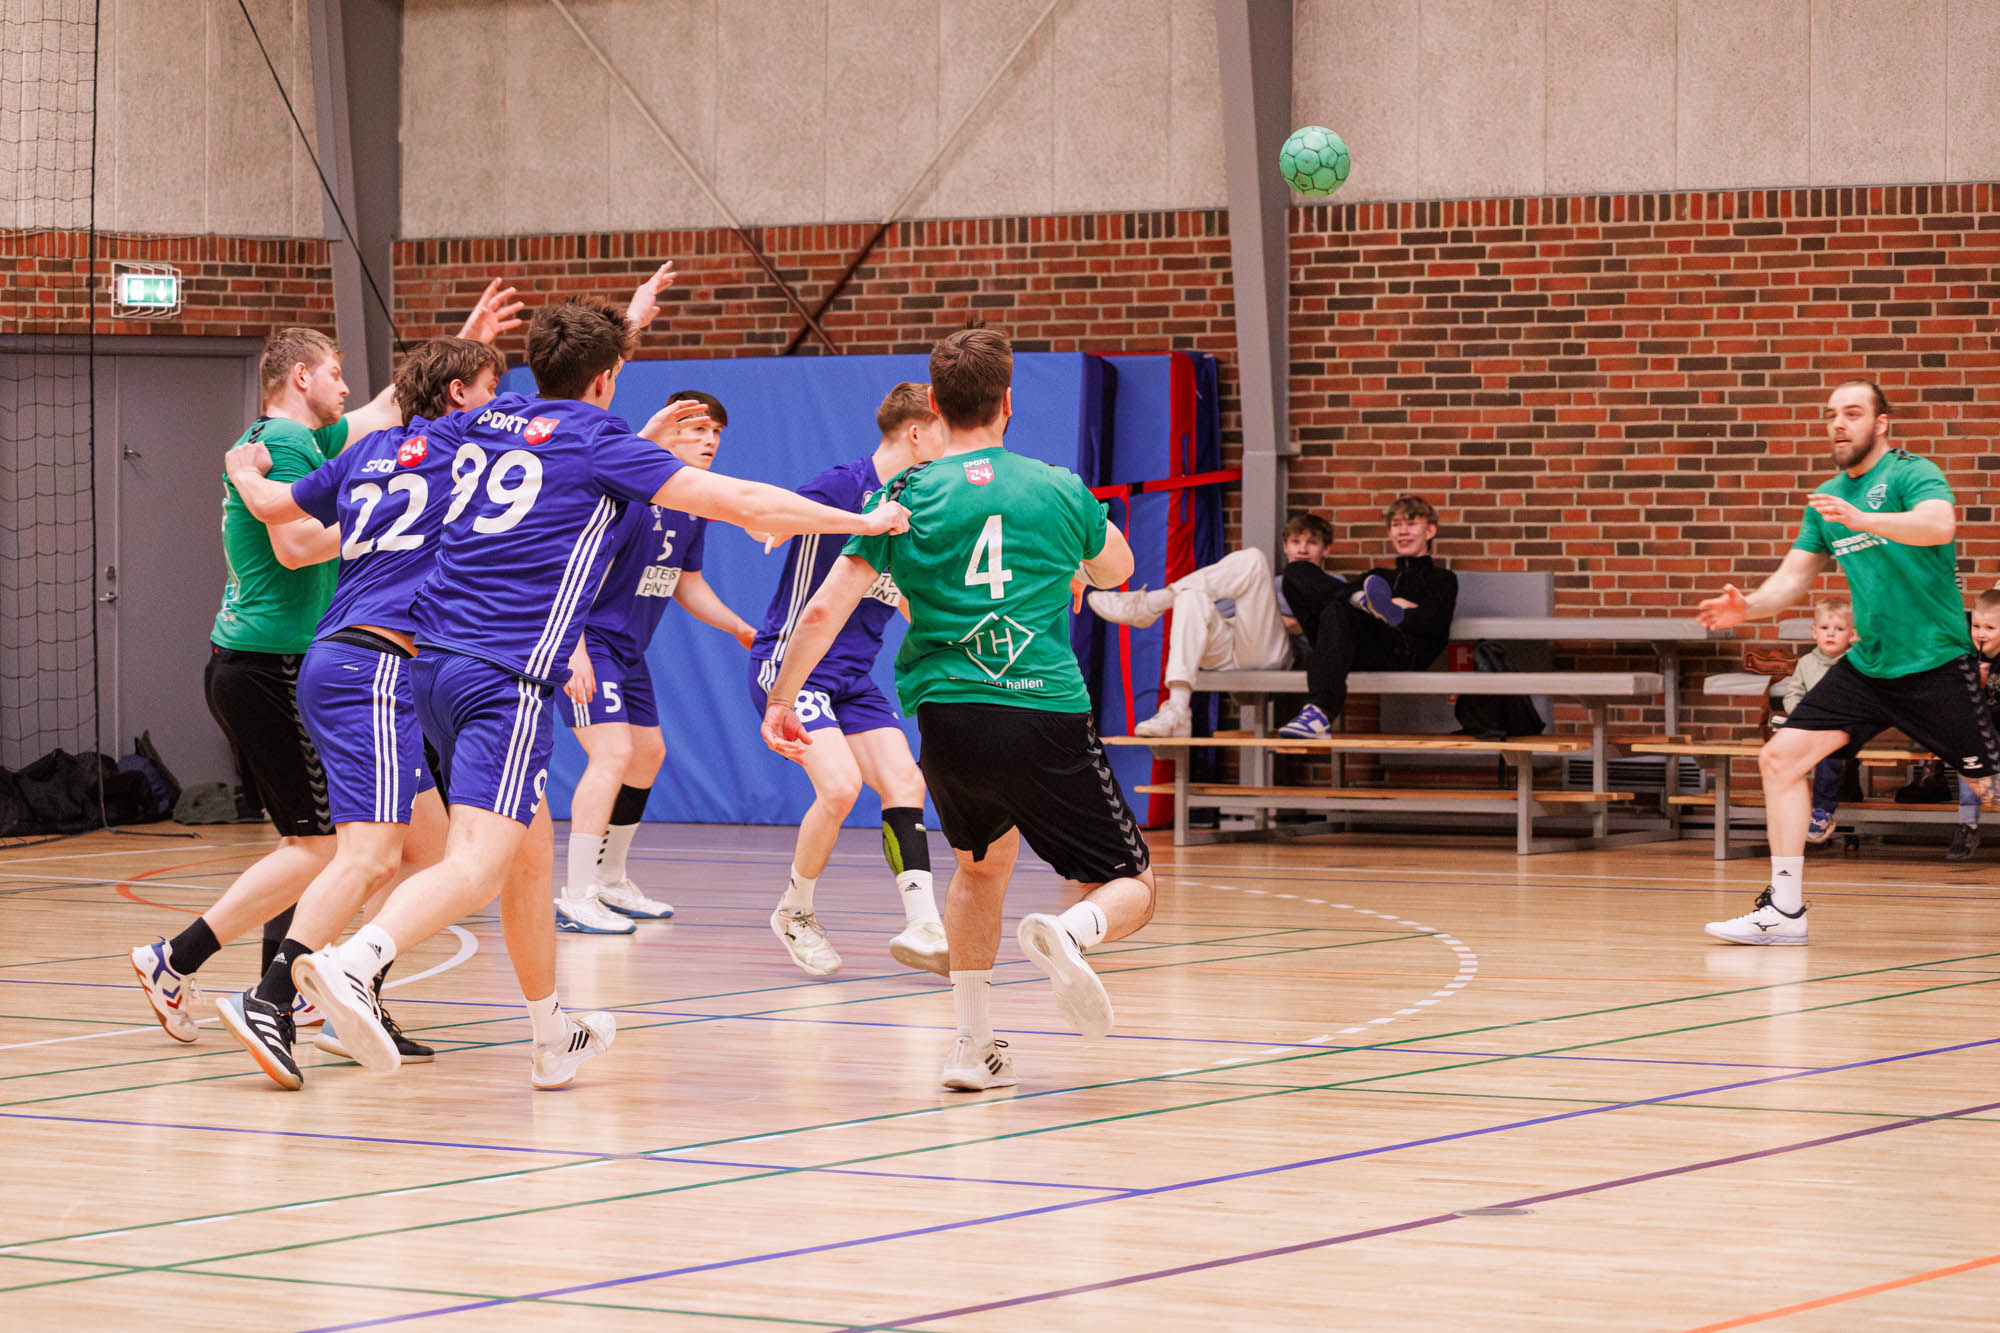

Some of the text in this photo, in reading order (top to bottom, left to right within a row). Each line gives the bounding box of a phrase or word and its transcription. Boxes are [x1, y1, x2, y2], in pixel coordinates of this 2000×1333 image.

[477, 409, 552, 438] PORT 24
[401, 440, 425, 462] 24
[962, 457, 991, 468] SPORT
[443, 442, 543, 534] 99
[969, 468, 993, 481] 24
[341, 472, 429, 561] 22
[656, 529, 677, 561] 5
[964, 514, 1013, 600] 4
[602, 681, 622, 713] 5
[1006, 678, 1044, 690] hallen
[794, 689, 837, 723] 88
